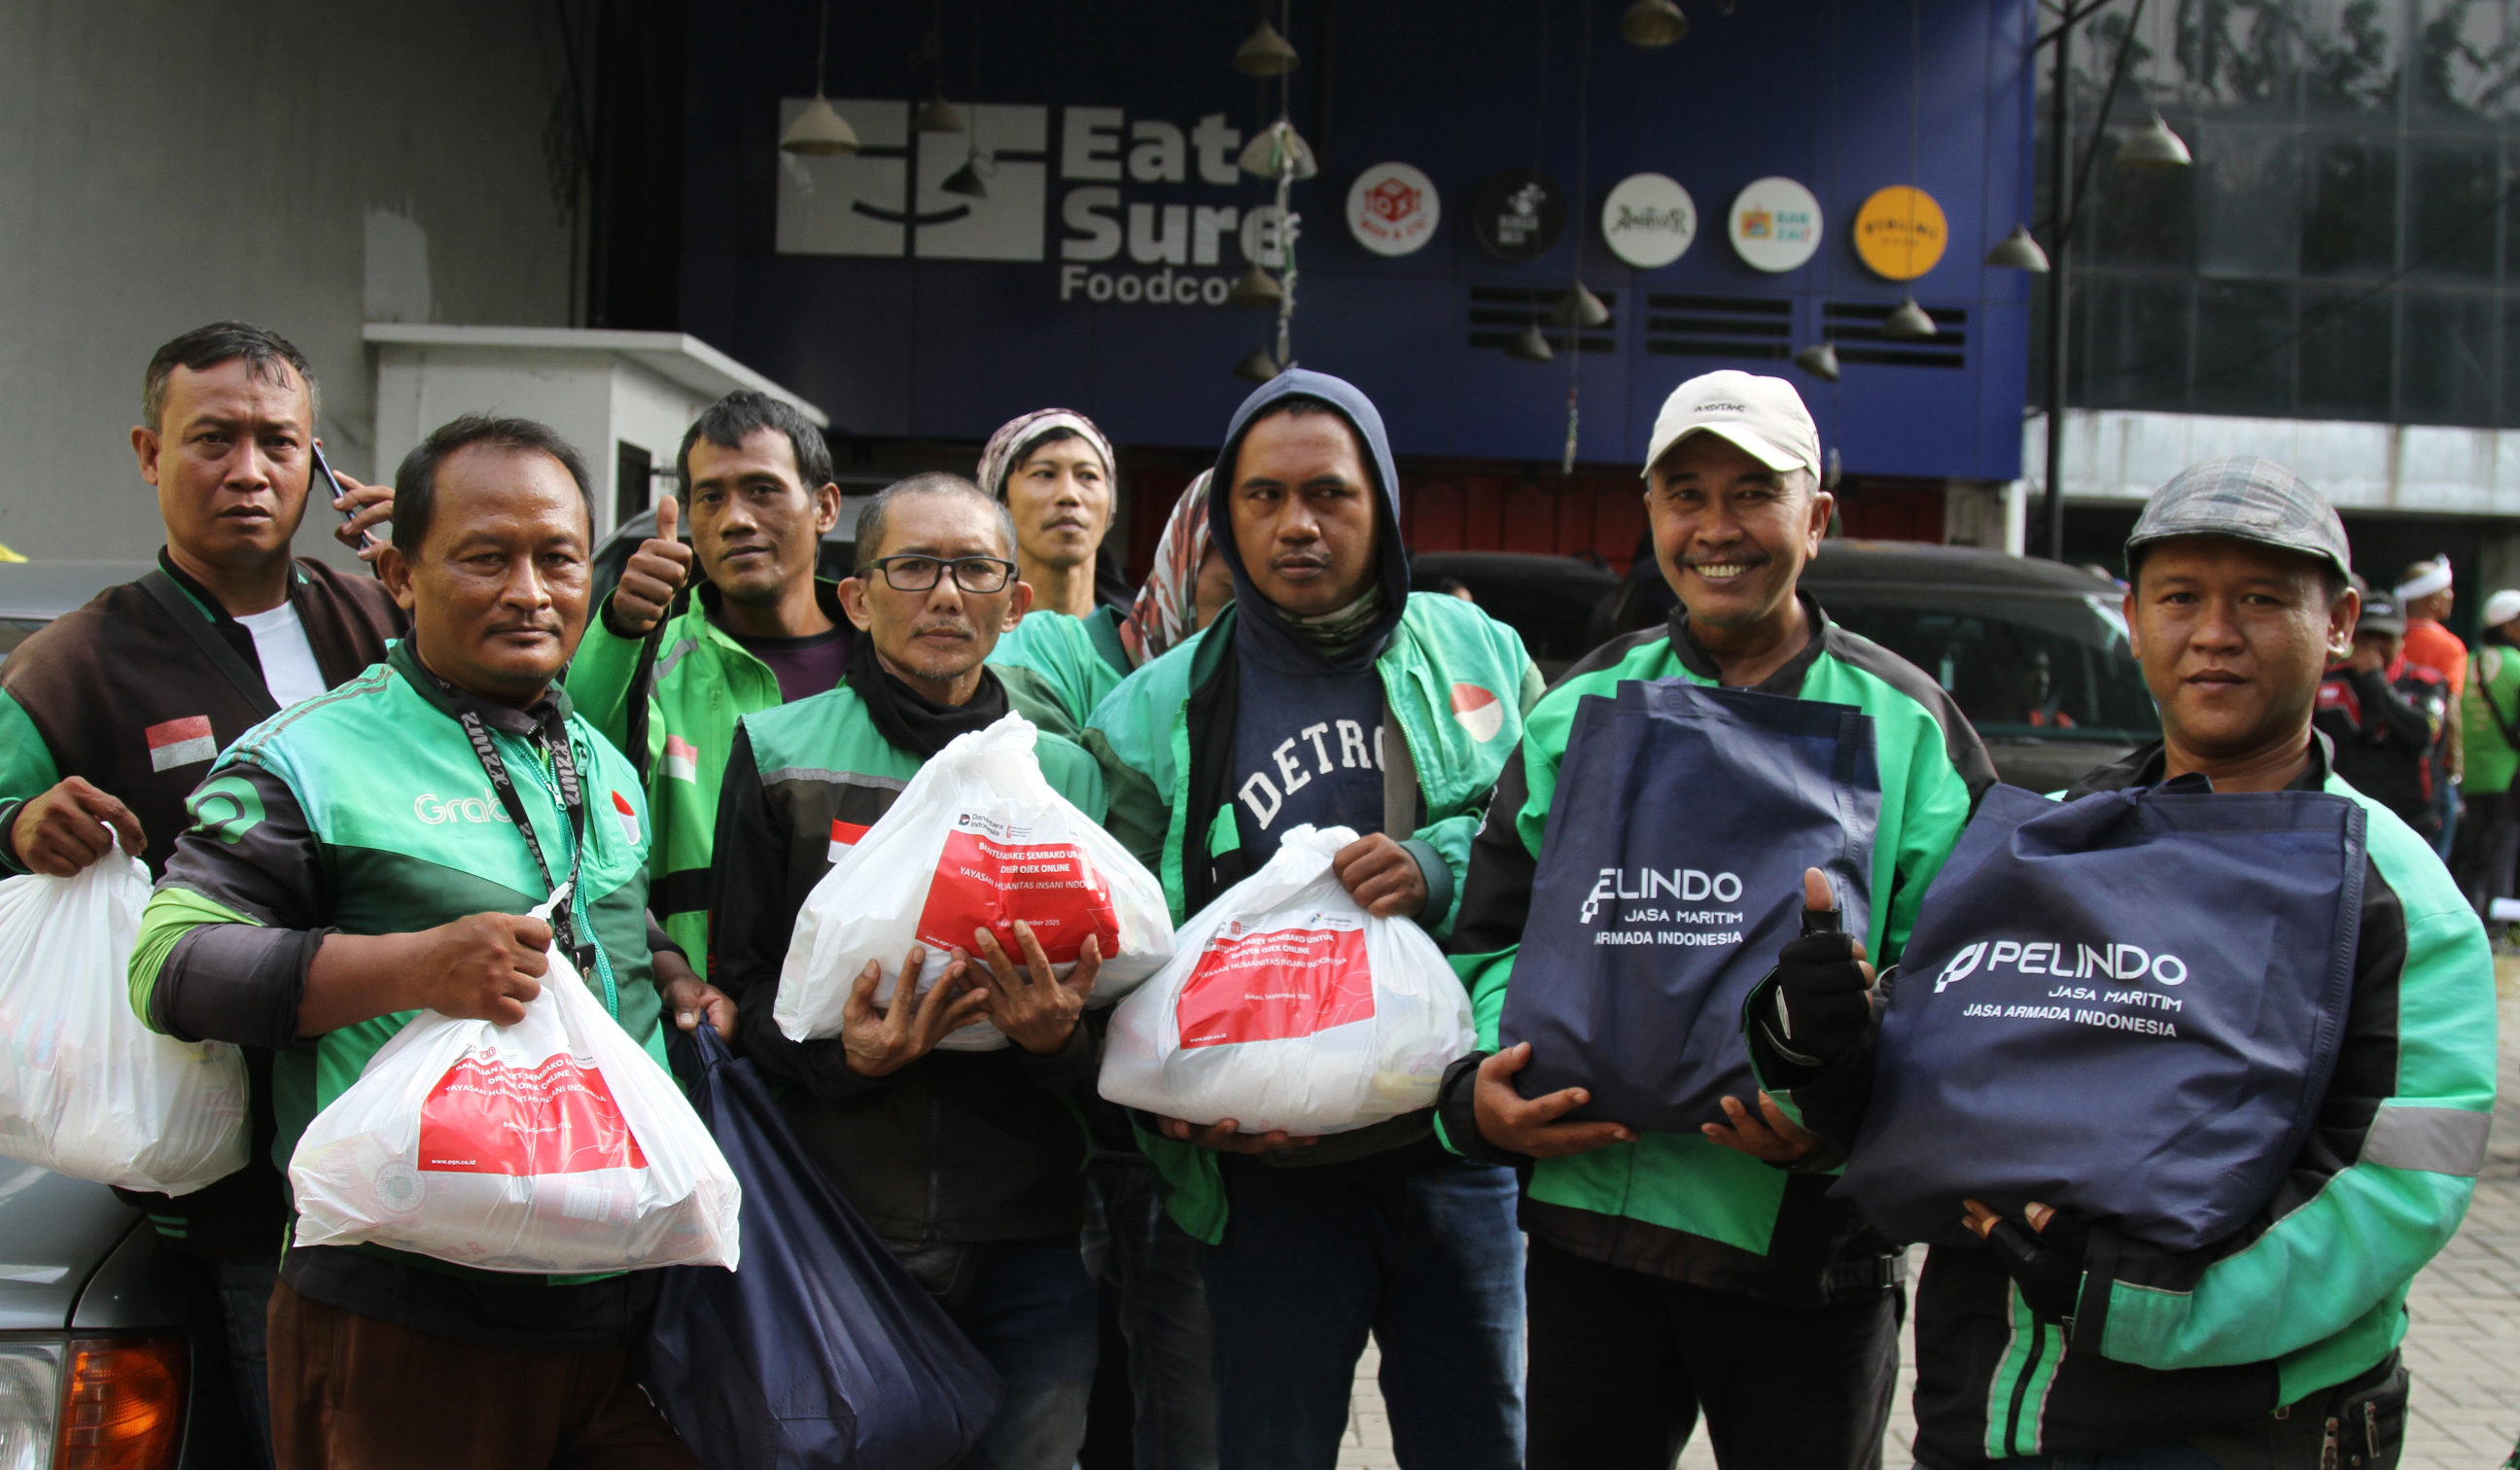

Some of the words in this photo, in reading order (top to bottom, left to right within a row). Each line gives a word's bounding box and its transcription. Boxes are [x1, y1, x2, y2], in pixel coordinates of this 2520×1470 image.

[1061, 106, 1242, 186] Eat
[1062, 186, 1285, 268] Sure
[1061, 264, 1240, 305] Foodco
[1238, 719, 1385, 830] DETR
[413, 788, 513, 825] Grab
[1026, 851, 1066, 860] SEMBAKO
[960, 866, 995, 886] YAYASAN
[1035, 881, 1064, 890] INSANI
[1020, 864, 1039, 874] OJEK
[1040, 863, 1070, 873] ONLINE
[1597, 867, 1743, 903] ELINDO
[1625, 909, 1670, 923] JASA
[1676, 911, 1743, 925] MARITIM
[1261, 945, 1282, 954] OJEK
[1282, 944, 1311, 955] ONLINE
[1267, 933, 1306, 943] SEMBAKO
[1306, 933, 1335, 944] UNTUK
[1594, 931, 1654, 946] ARMADA
[1658, 930, 1743, 947] INDONESIA
[1230, 958, 1280, 969] HUMANITAS
[1280, 959, 1306, 968] INSANI
[1986, 940, 2188, 986] PELINDO
[2048, 986, 2097, 1001] JASA
[2103, 991, 2183, 1013] MARITIM
[1963, 1003, 2002, 1018] JASA
[2004, 1005, 2071, 1021] ARMADA
[2074, 1009, 2178, 1038] INDONESIA
[455, 1062, 499, 1076] BANTUAN
[499, 1065, 523, 1080] PKET
[524, 1059, 564, 1081] SEMBAKO
[542, 1069, 571, 1090] ONLINE
[445, 1084, 487, 1096] YAYASAN
[541, 1085, 567, 1103] INSANI
